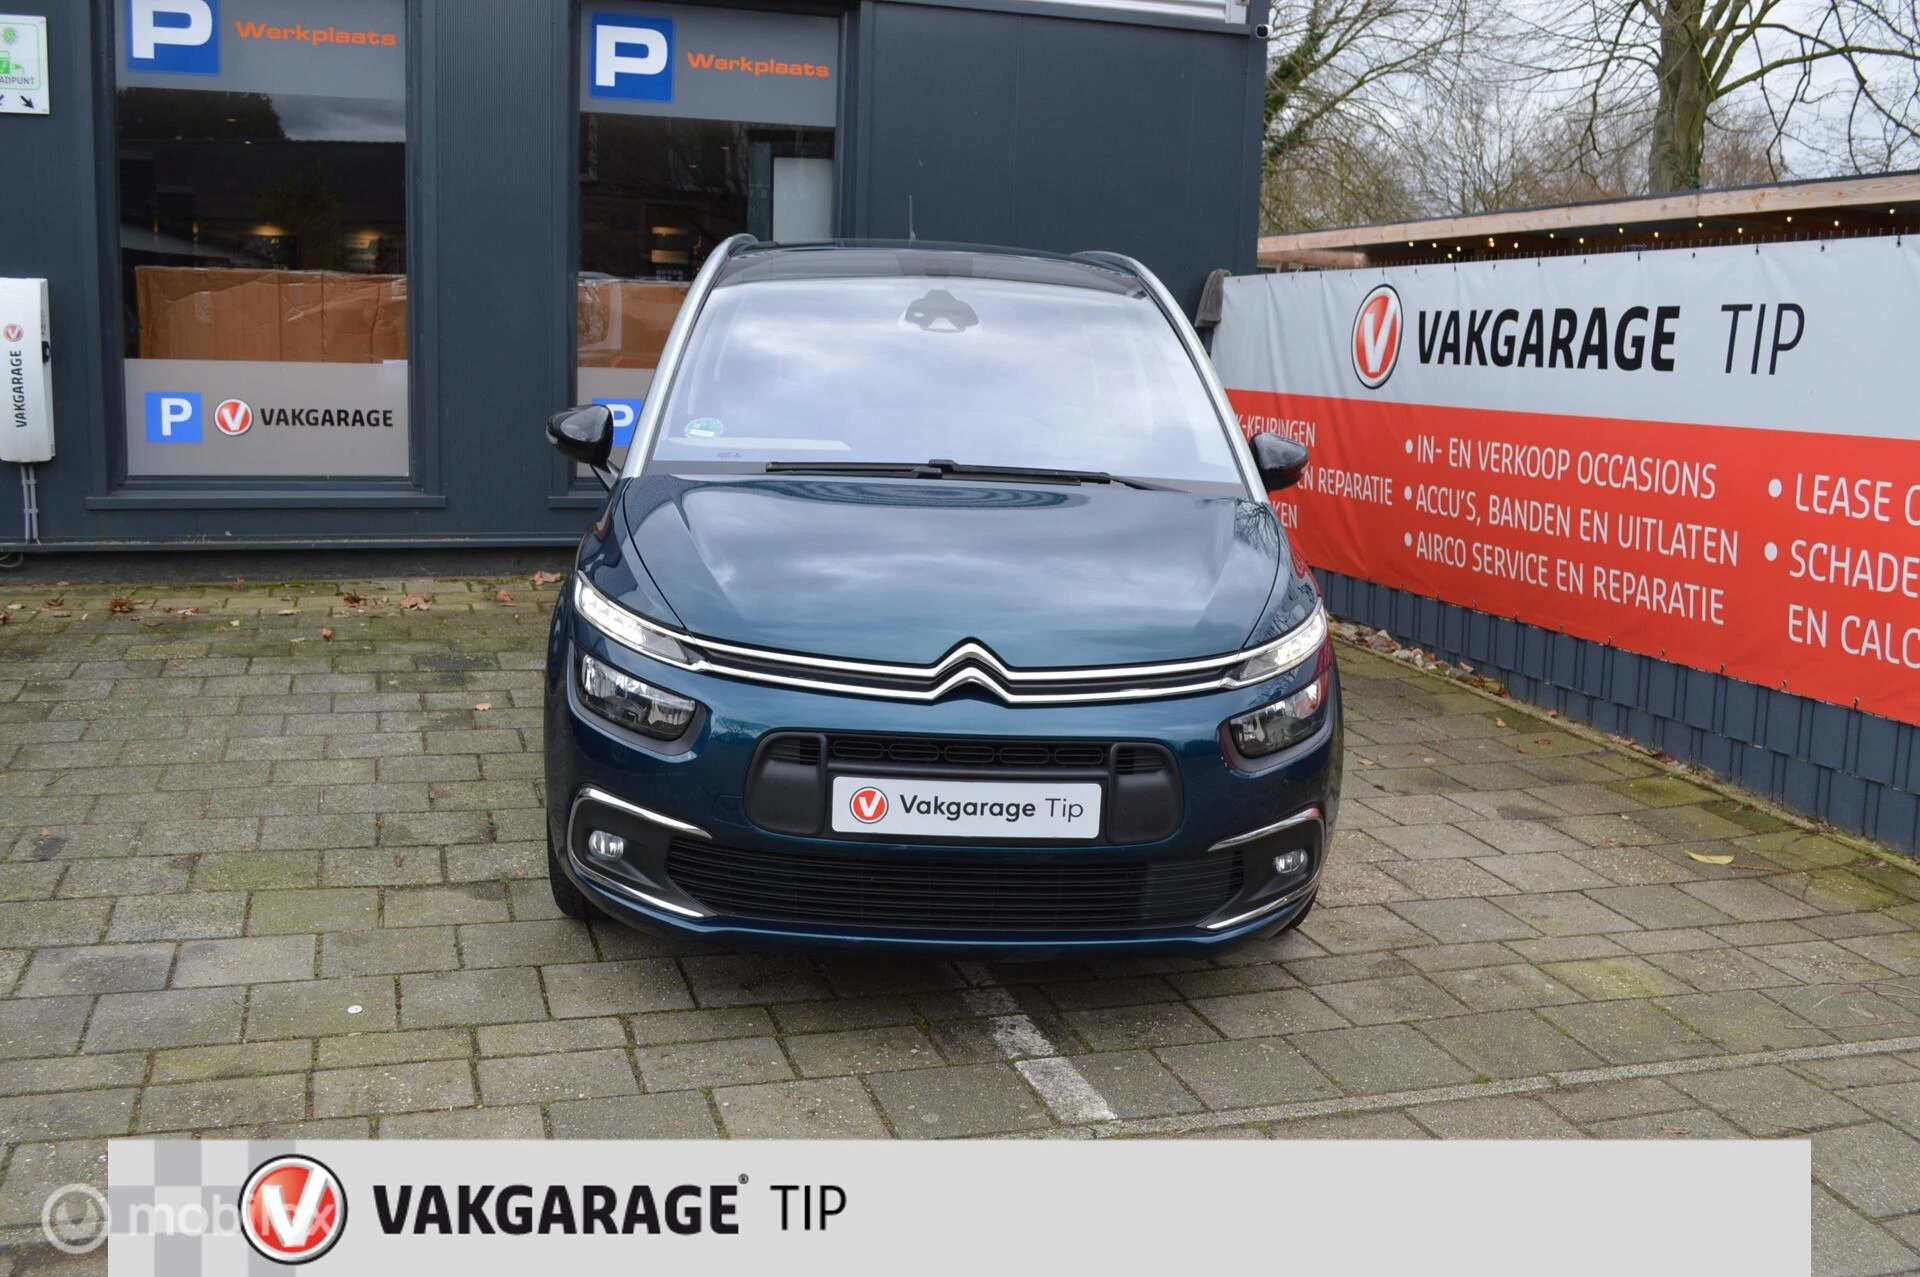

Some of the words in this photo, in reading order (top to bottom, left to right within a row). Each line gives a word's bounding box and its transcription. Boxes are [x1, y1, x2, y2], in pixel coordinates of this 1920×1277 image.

[132, 0, 212, 58] P
[235, 21, 397, 46] Werkplaats
[596, 24, 668, 87] P
[687, 52, 830, 77] Werkplaats
[1418, 305, 1680, 372] VAKGARAGE
[1721, 303, 1804, 375] TIP
[10, 350, 28, 428] VAKGARAGE
[161, 398, 193, 436] P
[260, 408, 393, 427] VAKGARAGE
[1318, 467, 1393, 506] REPARATIE
[1417, 434, 1442, 464] IN-
[1449, 437, 1471, 469] EN
[1478, 440, 1570, 480] VERKOOP
[1577, 451, 1716, 500] OCCASIONS
[1416, 483, 1481, 526] ACCU'S,
[1489, 494, 1571, 538] BANDEN
[1580, 508, 1608, 544] EN
[1618, 513, 1738, 567] UITLATEN
[1796, 472, 1893, 522] LEASE
[1416, 531, 1467, 568] AIRCO
[1472, 542, 1548, 587] SERVICE
[1556, 558, 1584, 595] EN
[1593, 566, 1724, 625] REPARATIE
[1789, 539, 1920, 598] SCHADE
[1788, 603, 1827, 649] EN
[1841, 615, 1920, 669] CALC
[900, 794, 1036, 823] Vakgarage
[1045, 797, 1084, 823] Tip
